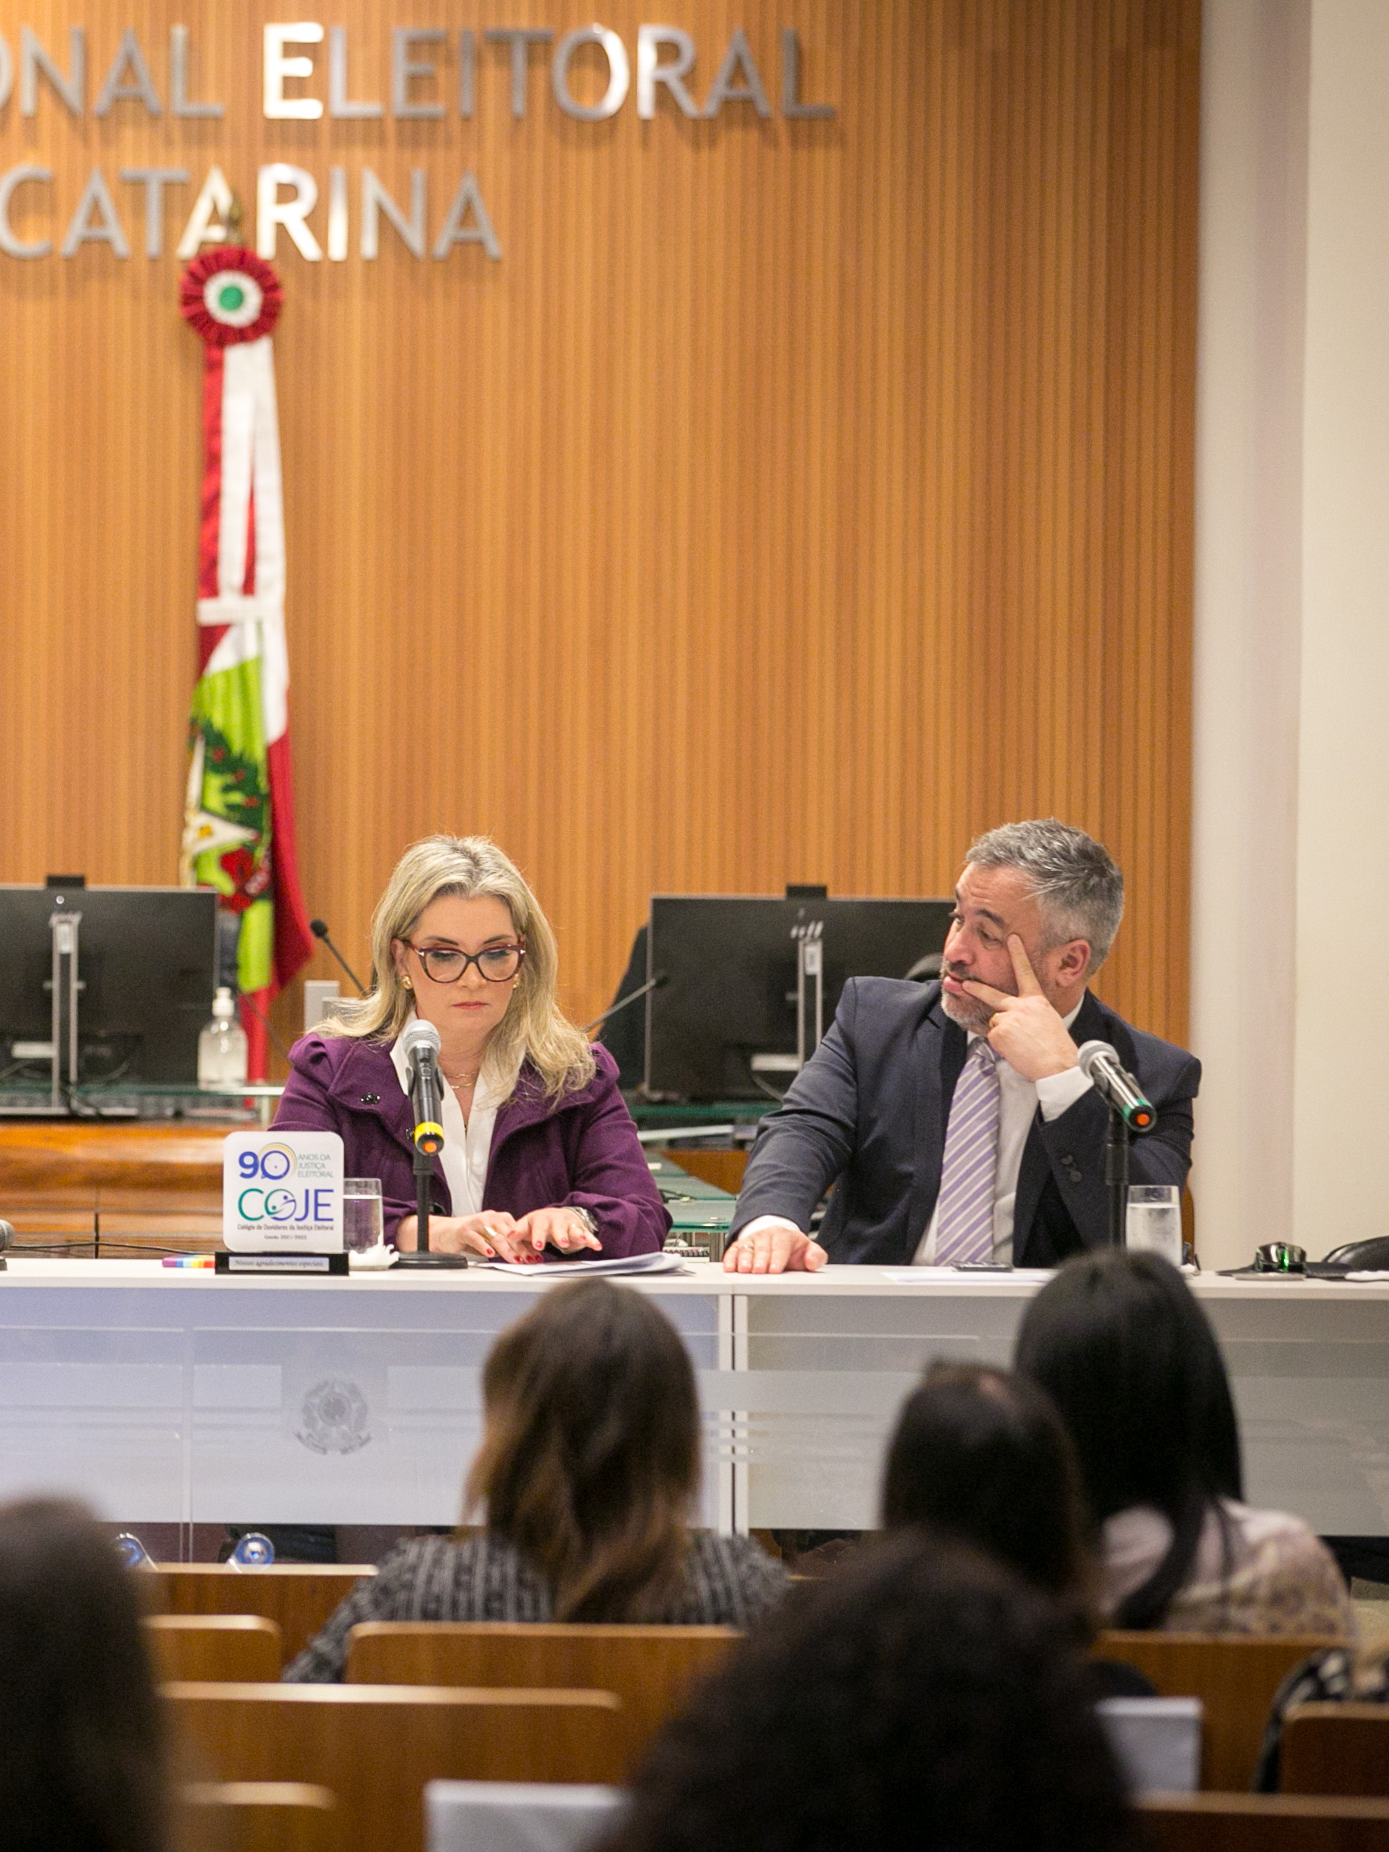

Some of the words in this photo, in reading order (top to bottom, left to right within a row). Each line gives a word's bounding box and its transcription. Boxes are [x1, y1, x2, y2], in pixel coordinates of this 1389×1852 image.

[263, 21, 837, 121] ELEITORAL
[238, 1150, 291, 1181] 90
[297, 1162, 326, 1171] JUSTIÇA
[297, 1171, 334, 1179] ELEITORAL
[238, 1187, 335, 1222] COJE
